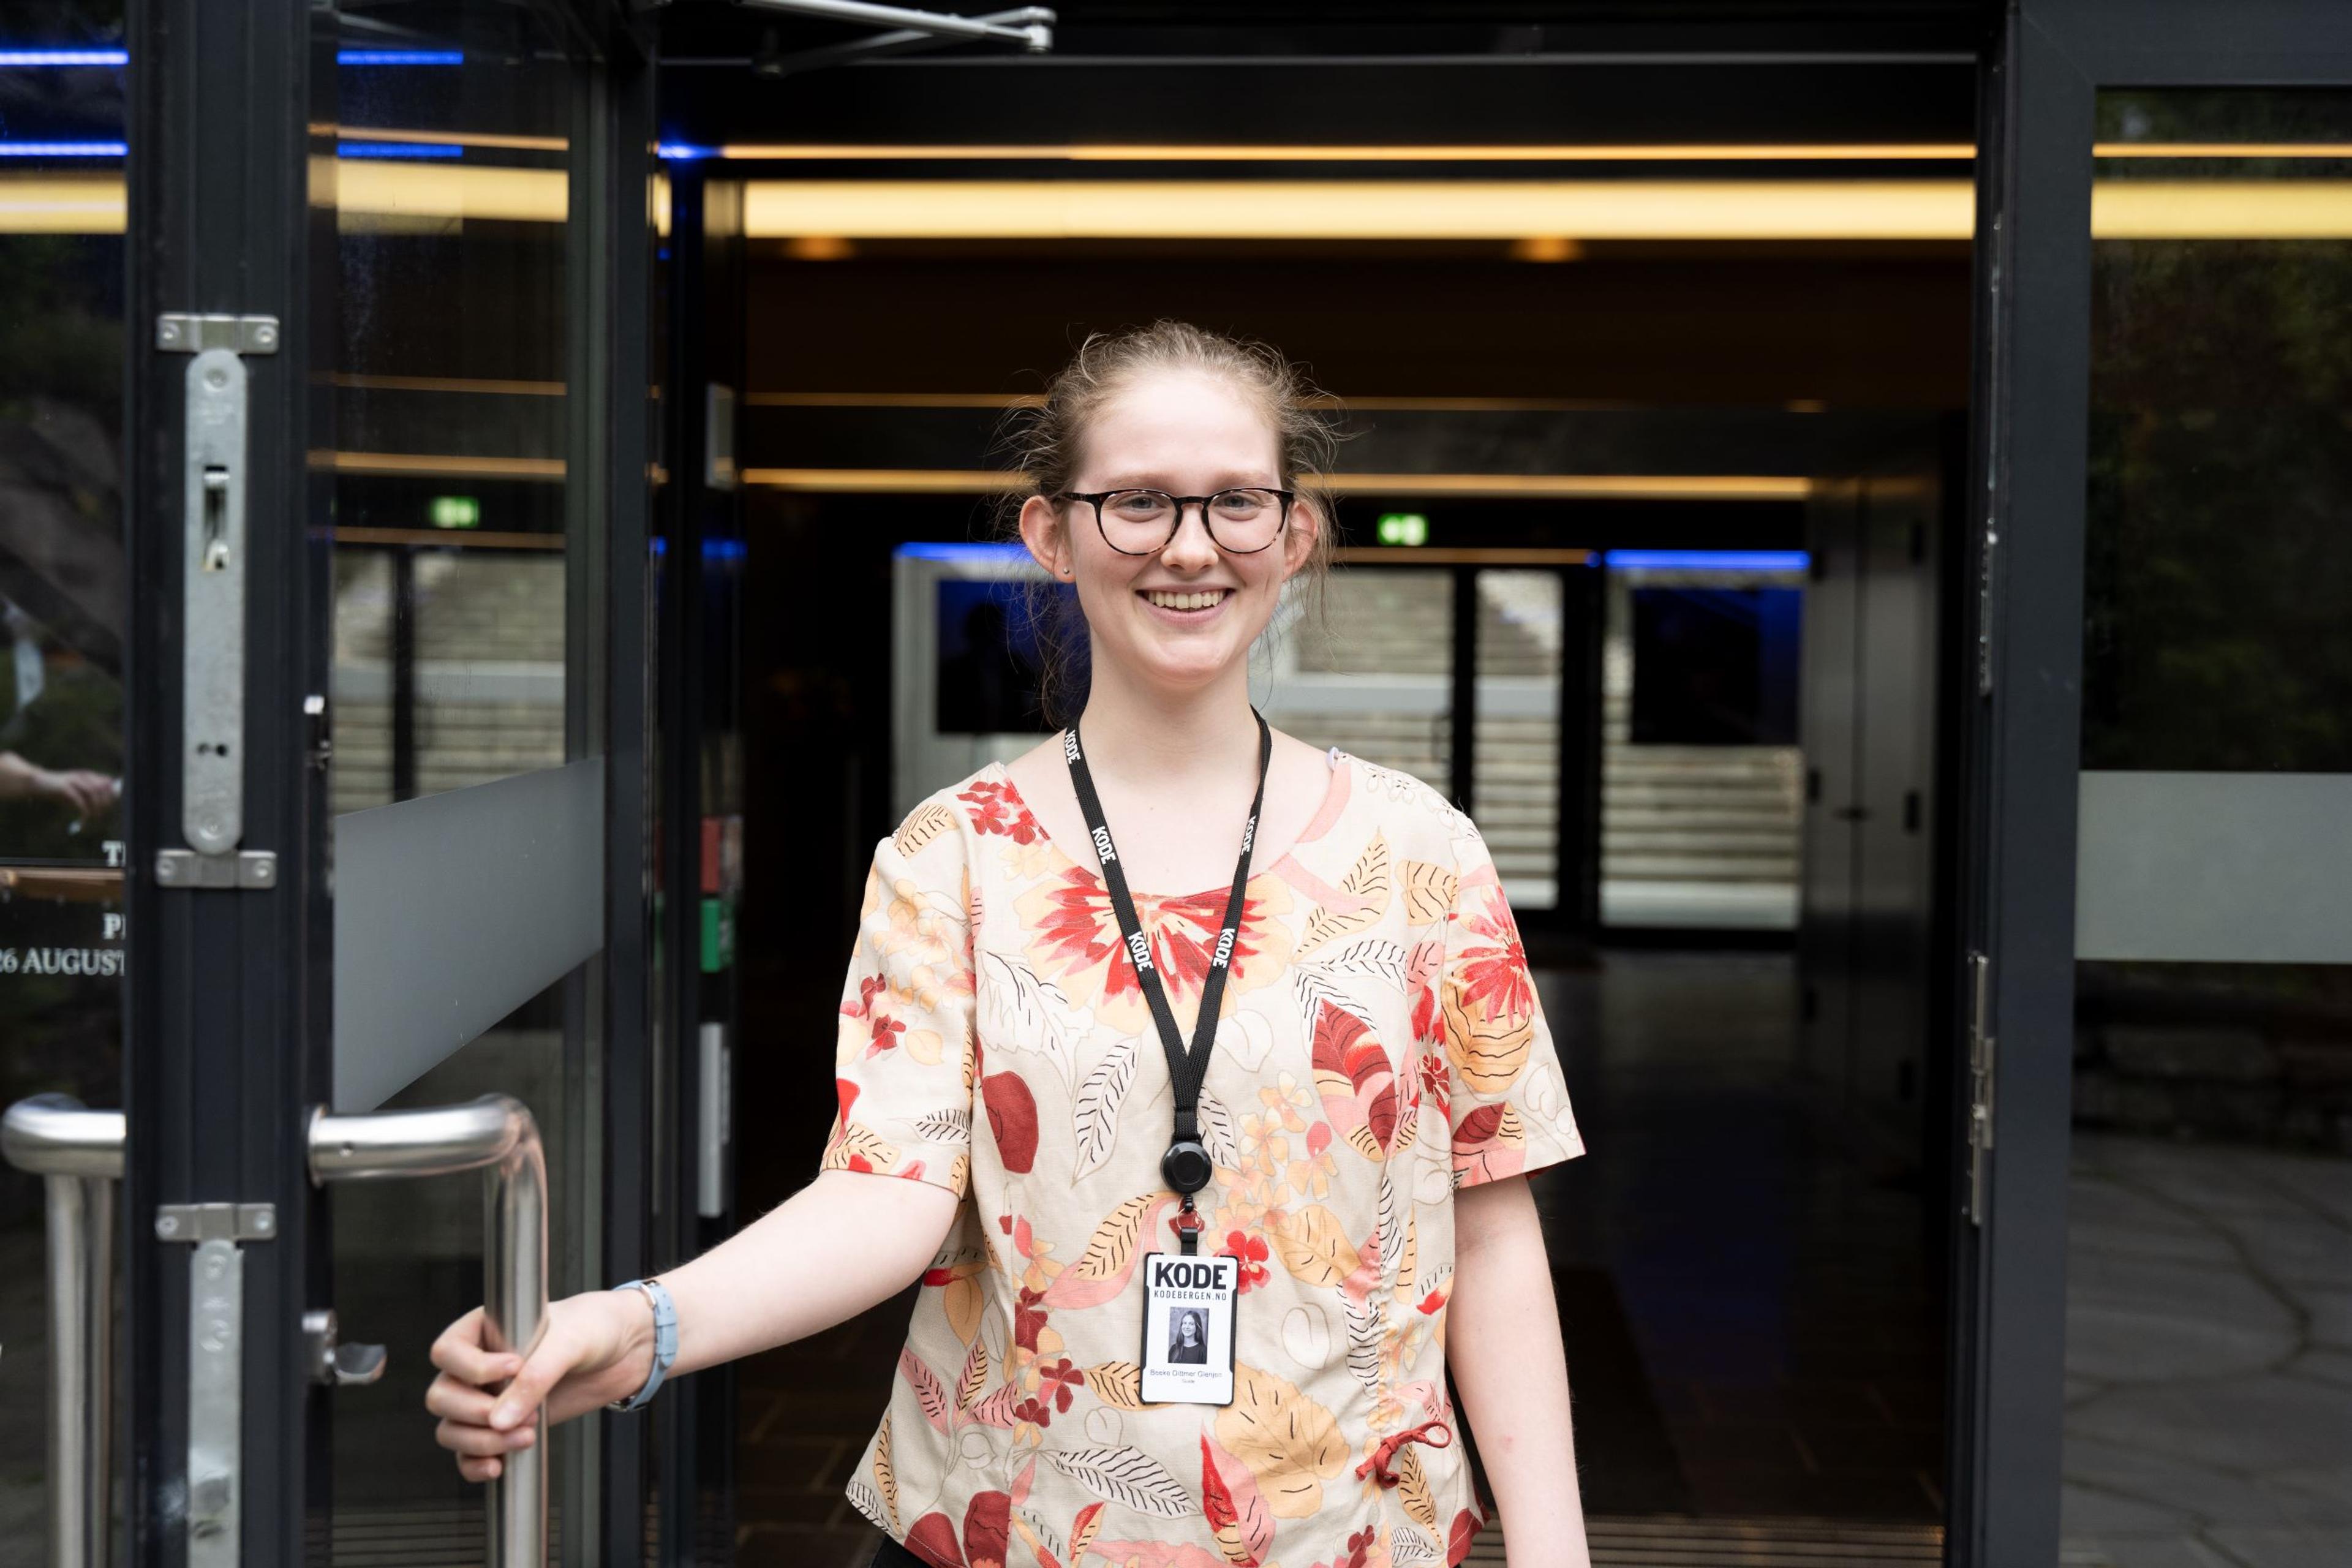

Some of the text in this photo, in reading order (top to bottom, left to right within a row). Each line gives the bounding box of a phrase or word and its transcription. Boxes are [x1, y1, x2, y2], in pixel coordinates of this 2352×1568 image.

[1065, 729, 1081, 764] KODE
[1092, 826, 1116, 865] KODE
[1241, 815, 1257, 856] KODE
[101, 840, 126, 867] T
[102, 913, 126, 940] P
[0, 948, 18, 974] 6
[1128, 930, 1154, 972] KODE
[1213, 928, 1235, 969] KODE
[1155, 1262, 1227, 1290] KODE
[1154, 1290, 1227, 1301] KODEBERGEN.NO
